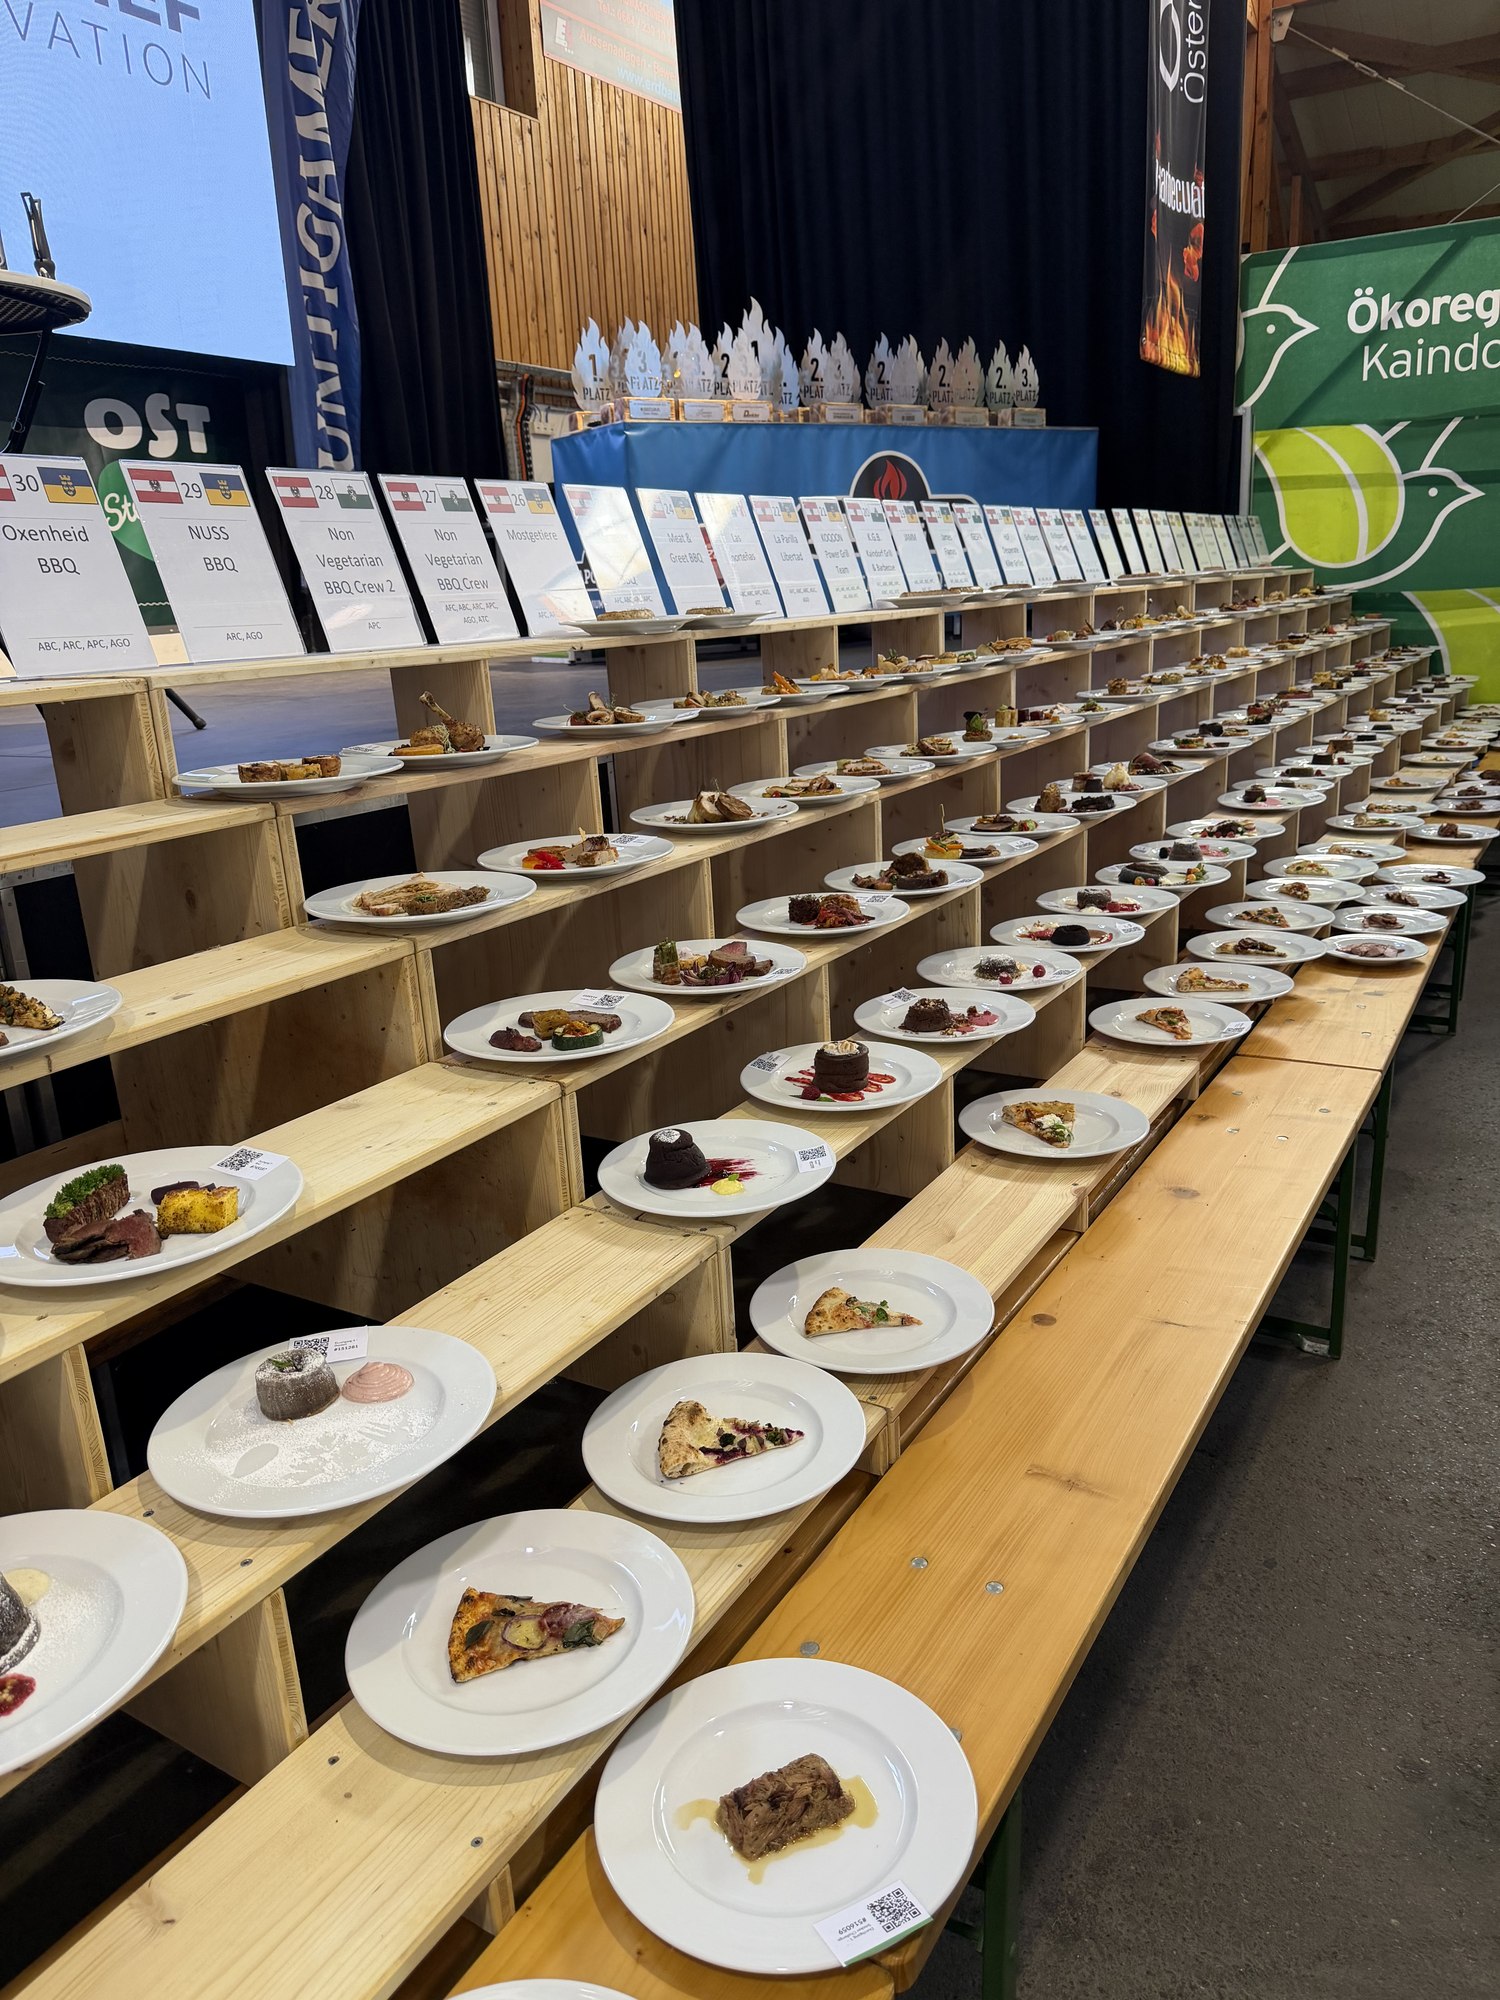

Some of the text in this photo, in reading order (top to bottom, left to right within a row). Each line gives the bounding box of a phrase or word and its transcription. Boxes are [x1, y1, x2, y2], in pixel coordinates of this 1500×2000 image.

[810, 358, 824, 382] 2.
[877, 361, 890, 385] 2.
[938, 365, 951, 388] 2.
[995, 366, 1007, 389] 2.
[1021, 368, 1032, 387] 3.
[582, 387, 611, 400] PLATZ
[803, 385, 825, 399] PLAT
[989, 392, 1011, 405] PLATZ
[1016, 390, 1037, 402] PLATZ
[84, 392, 211, 458] OST
[12, 474, 40, 492] 30
[181, 482, 202, 498] 29
[315, 485, 335, 500] 28
[421, 490, 437, 504] 27
[511, 493, 526, 507] 26
[2, 525, 90, 542] Oxenheid
[188, 525, 230, 540] NUSS
[328, 527, 355, 541] Non
[434, 528, 458, 541] Non
[506, 529, 558, 543] Mostgetiere
[203, 557, 239, 573] BBQ
[316, 554, 384, 571] Vegetarian
[425, 553, 483, 569] Vegetarian
[669, 552, 705, 564] Greet BBQ
[37, 557, 81, 575] BBQ
[324, 580, 396, 595] BBQ Crew 2
[437, 578, 489, 591] BBQ Crew
[368, 621, 381, 630] APC
[226, 632, 263, 642] ARC, AGO
[38, 638, 131, 652] ABC, ARC, APC, AGO
